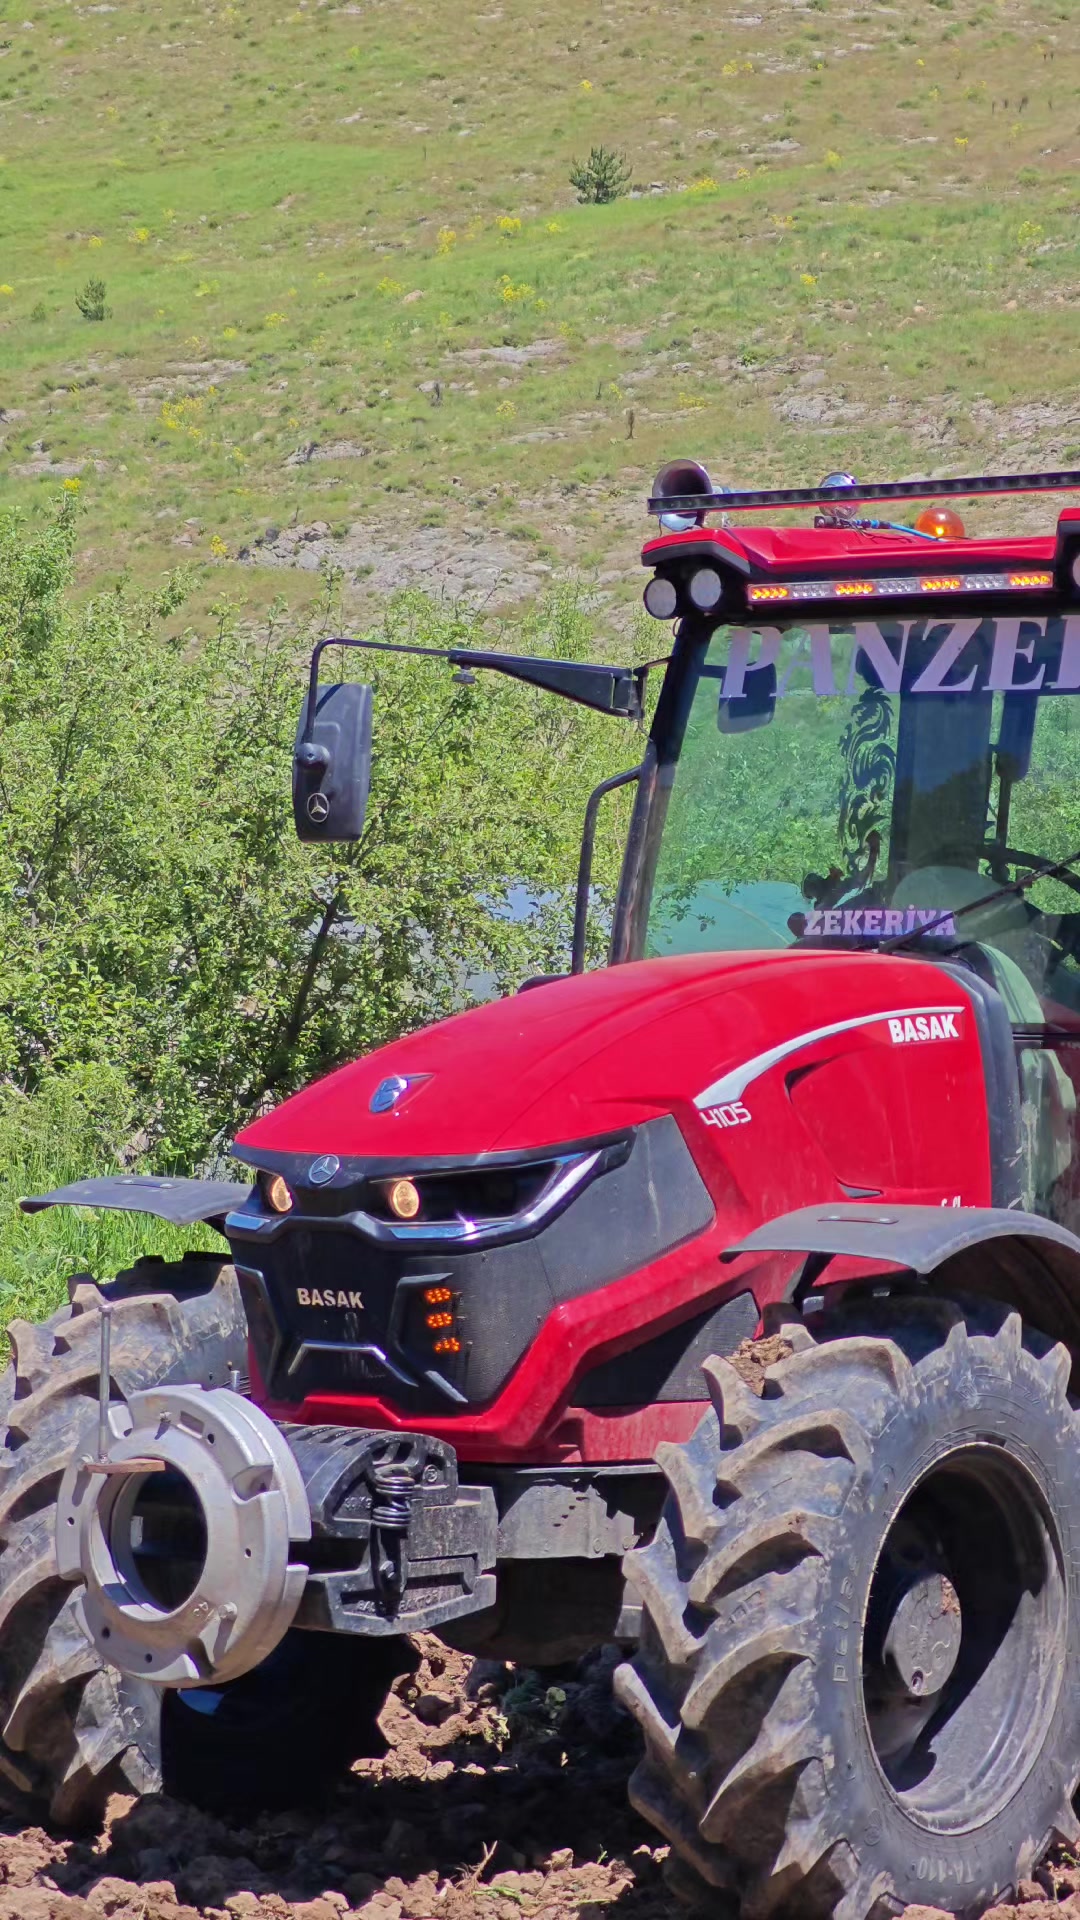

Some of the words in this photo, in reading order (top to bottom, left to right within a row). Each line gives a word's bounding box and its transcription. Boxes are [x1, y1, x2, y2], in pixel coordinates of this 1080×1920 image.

[803, 904, 956, 936] ZEKERİYA
[888, 1013, 960, 1043] BASAK
[699, 1101, 752, 1129] 4105
[296, 1287, 365, 1309] BASAK
